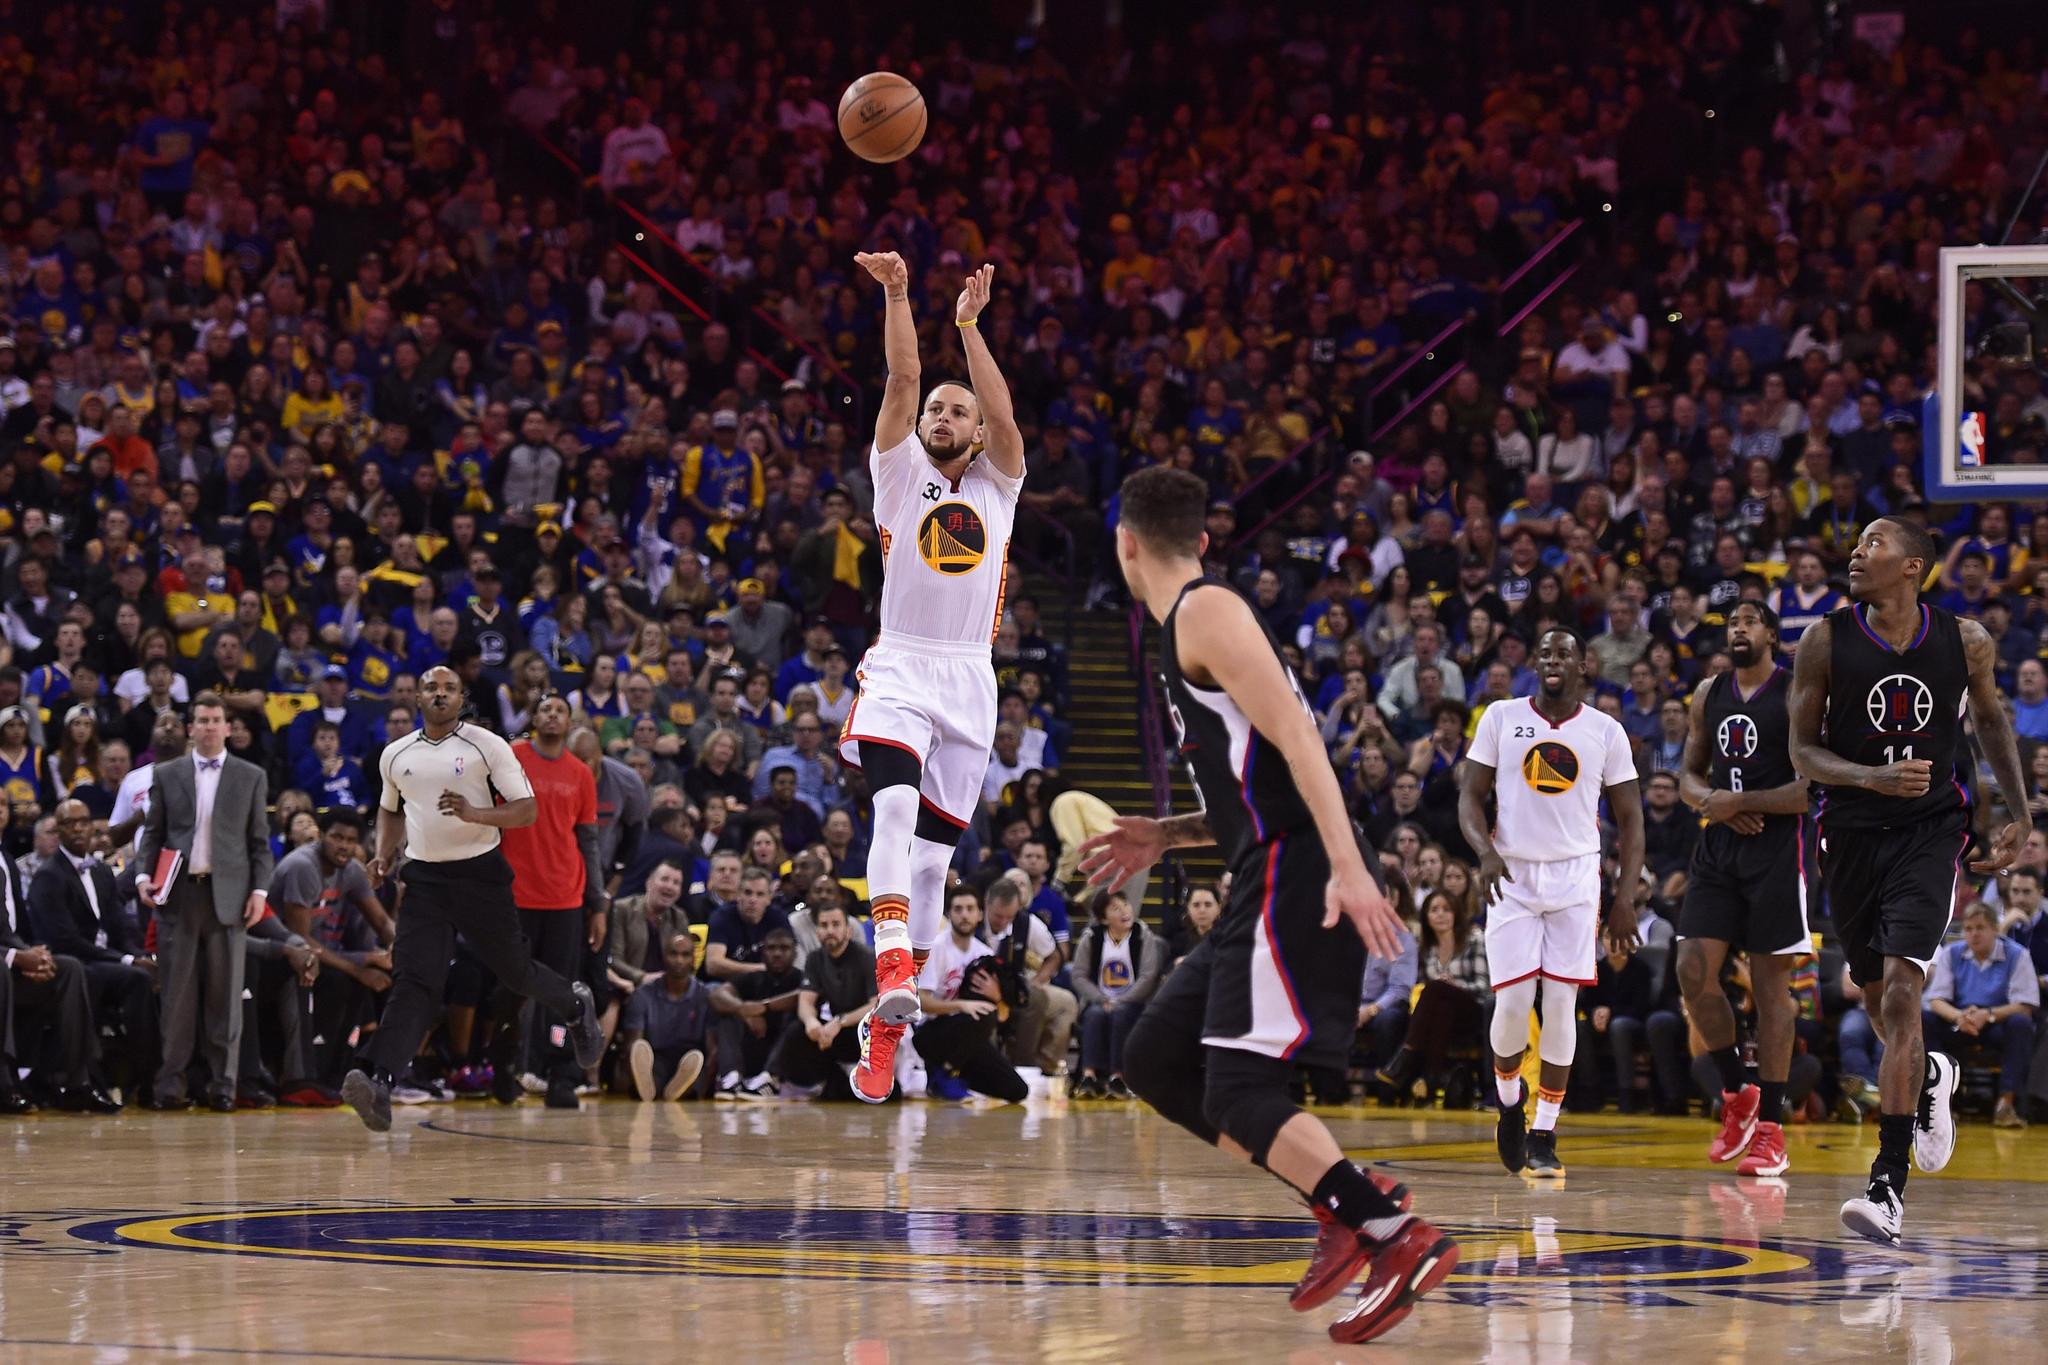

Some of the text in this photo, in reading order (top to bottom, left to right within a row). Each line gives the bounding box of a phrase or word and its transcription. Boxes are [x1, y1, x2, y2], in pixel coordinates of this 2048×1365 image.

[921, 482, 942, 501] 30
[1514, 726, 1535, 738] 23
[1730, 767, 1743, 792] 6
